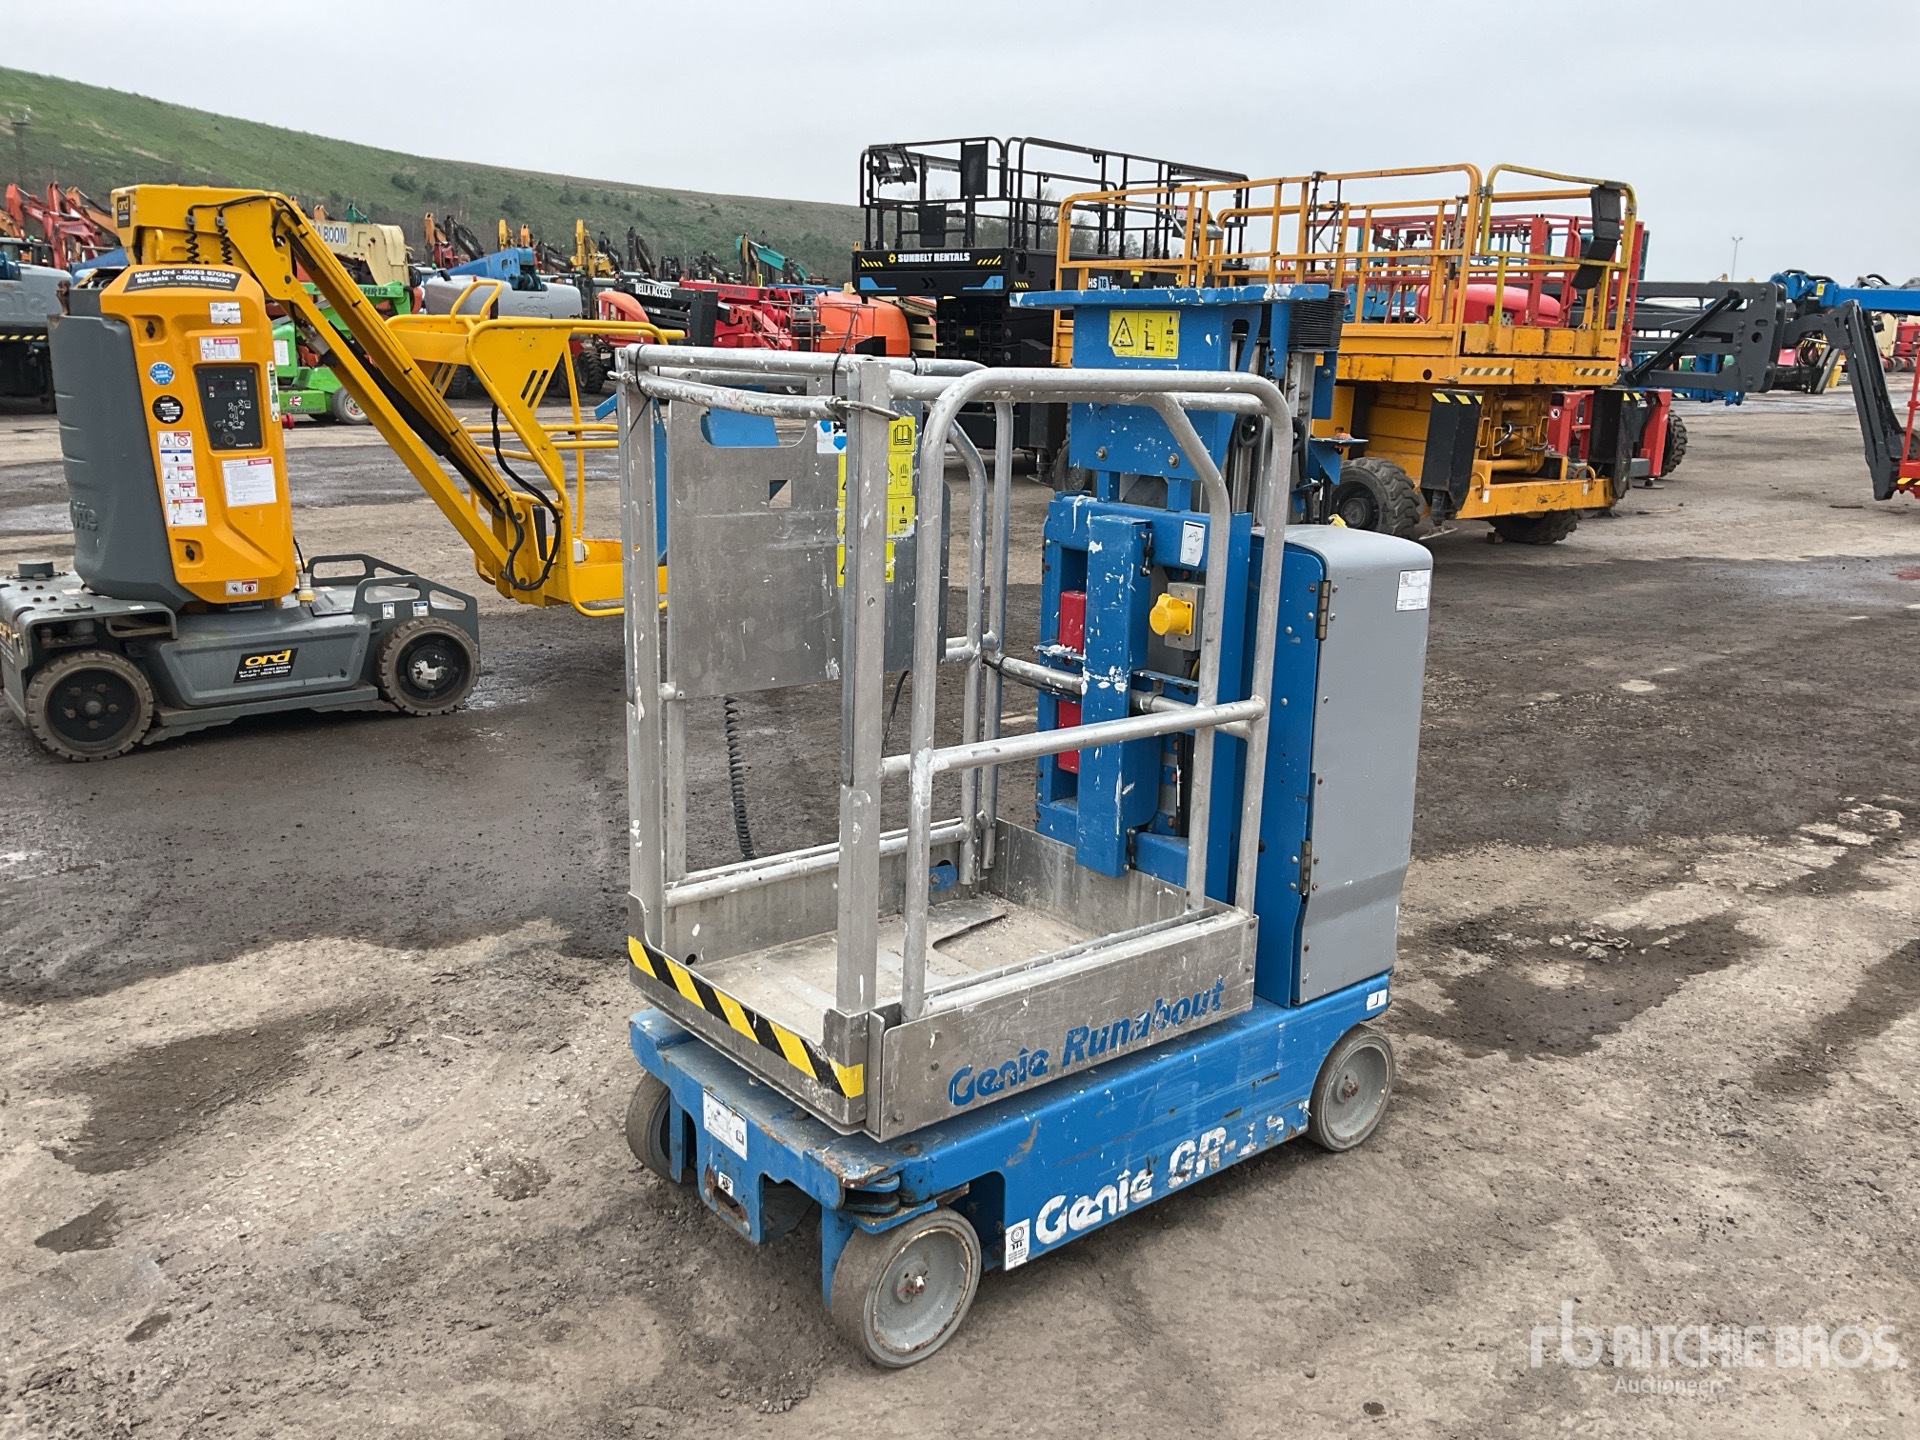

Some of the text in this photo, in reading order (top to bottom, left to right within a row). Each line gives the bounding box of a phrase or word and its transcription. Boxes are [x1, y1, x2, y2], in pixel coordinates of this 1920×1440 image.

[323, 225, 347, 244] BOOM
[897, 252, 971, 263] SUNBELT RENTALS
[134, 271, 151, 279] Muir
[1087, 277, 1107, 289] HS 18
[635, 283, 672, 299] BELLA ACCESS
[245, 649, 292, 667] ord
[948, 976, 1225, 1107] Genie Runabout
[1035, 1169, 1154, 1245] Genie
